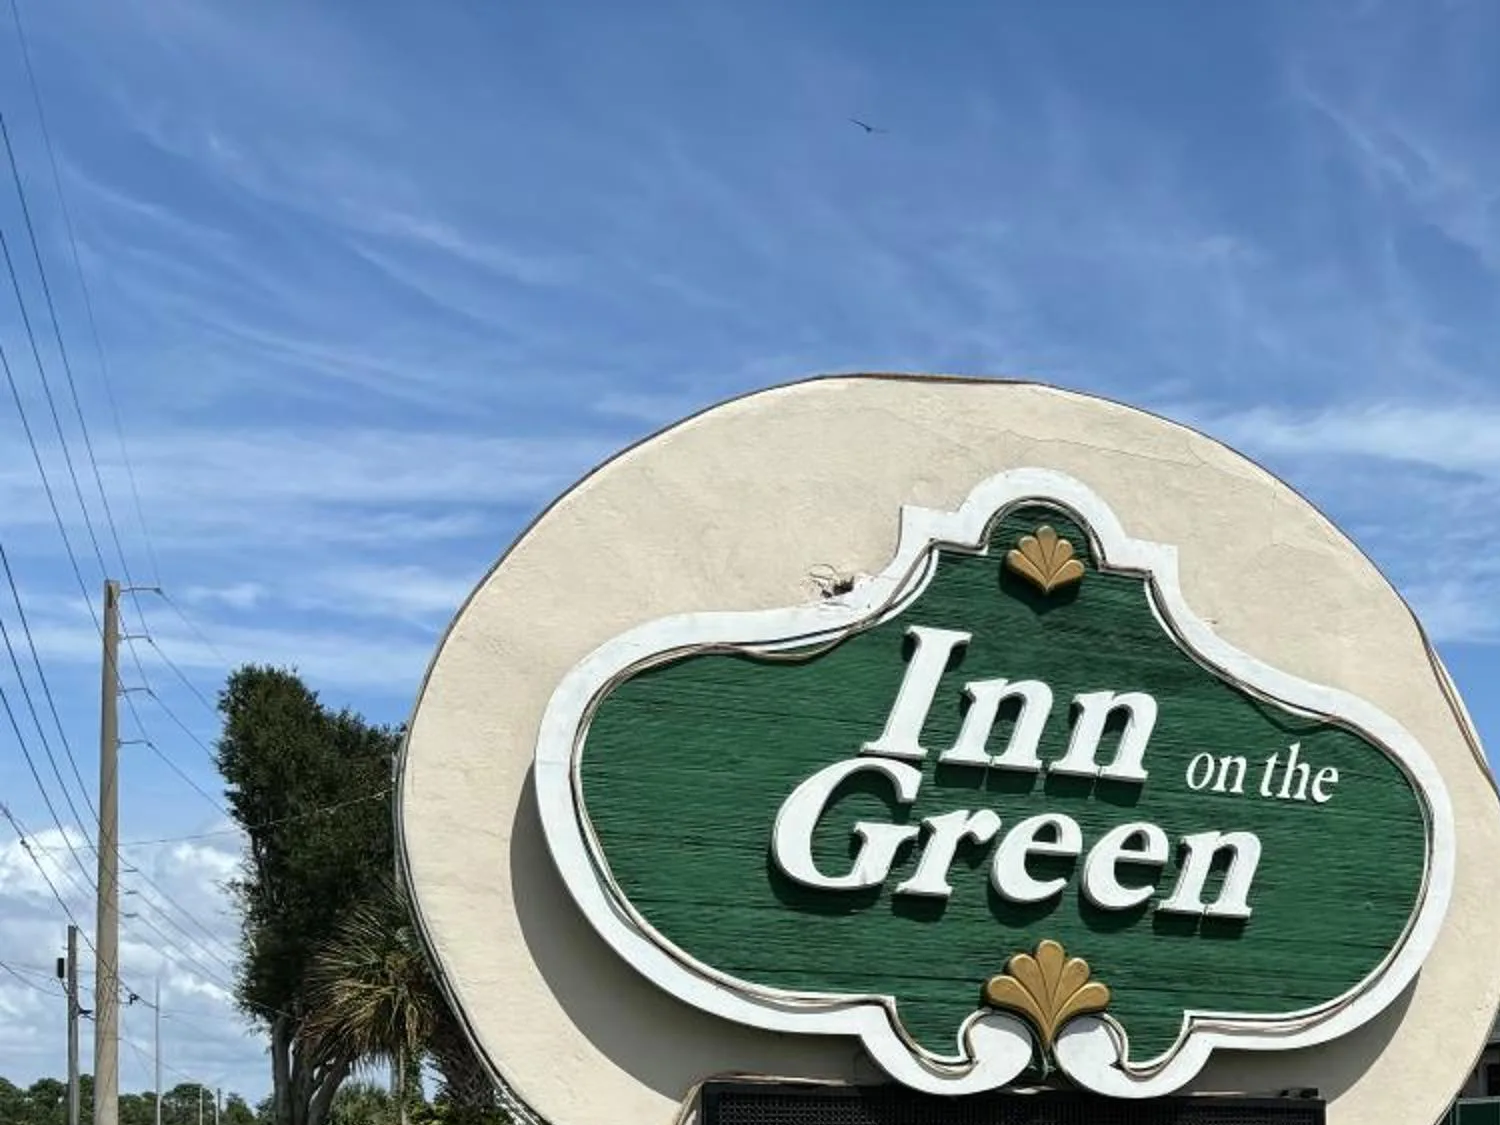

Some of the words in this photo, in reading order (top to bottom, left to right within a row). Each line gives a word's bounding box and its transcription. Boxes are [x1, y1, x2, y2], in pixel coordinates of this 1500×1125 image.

[860, 625, 1158, 782] Inn
[1186, 752, 1247, 793] on
[1260, 741, 1339, 803] the
[771, 757, 1262, 919] Green
